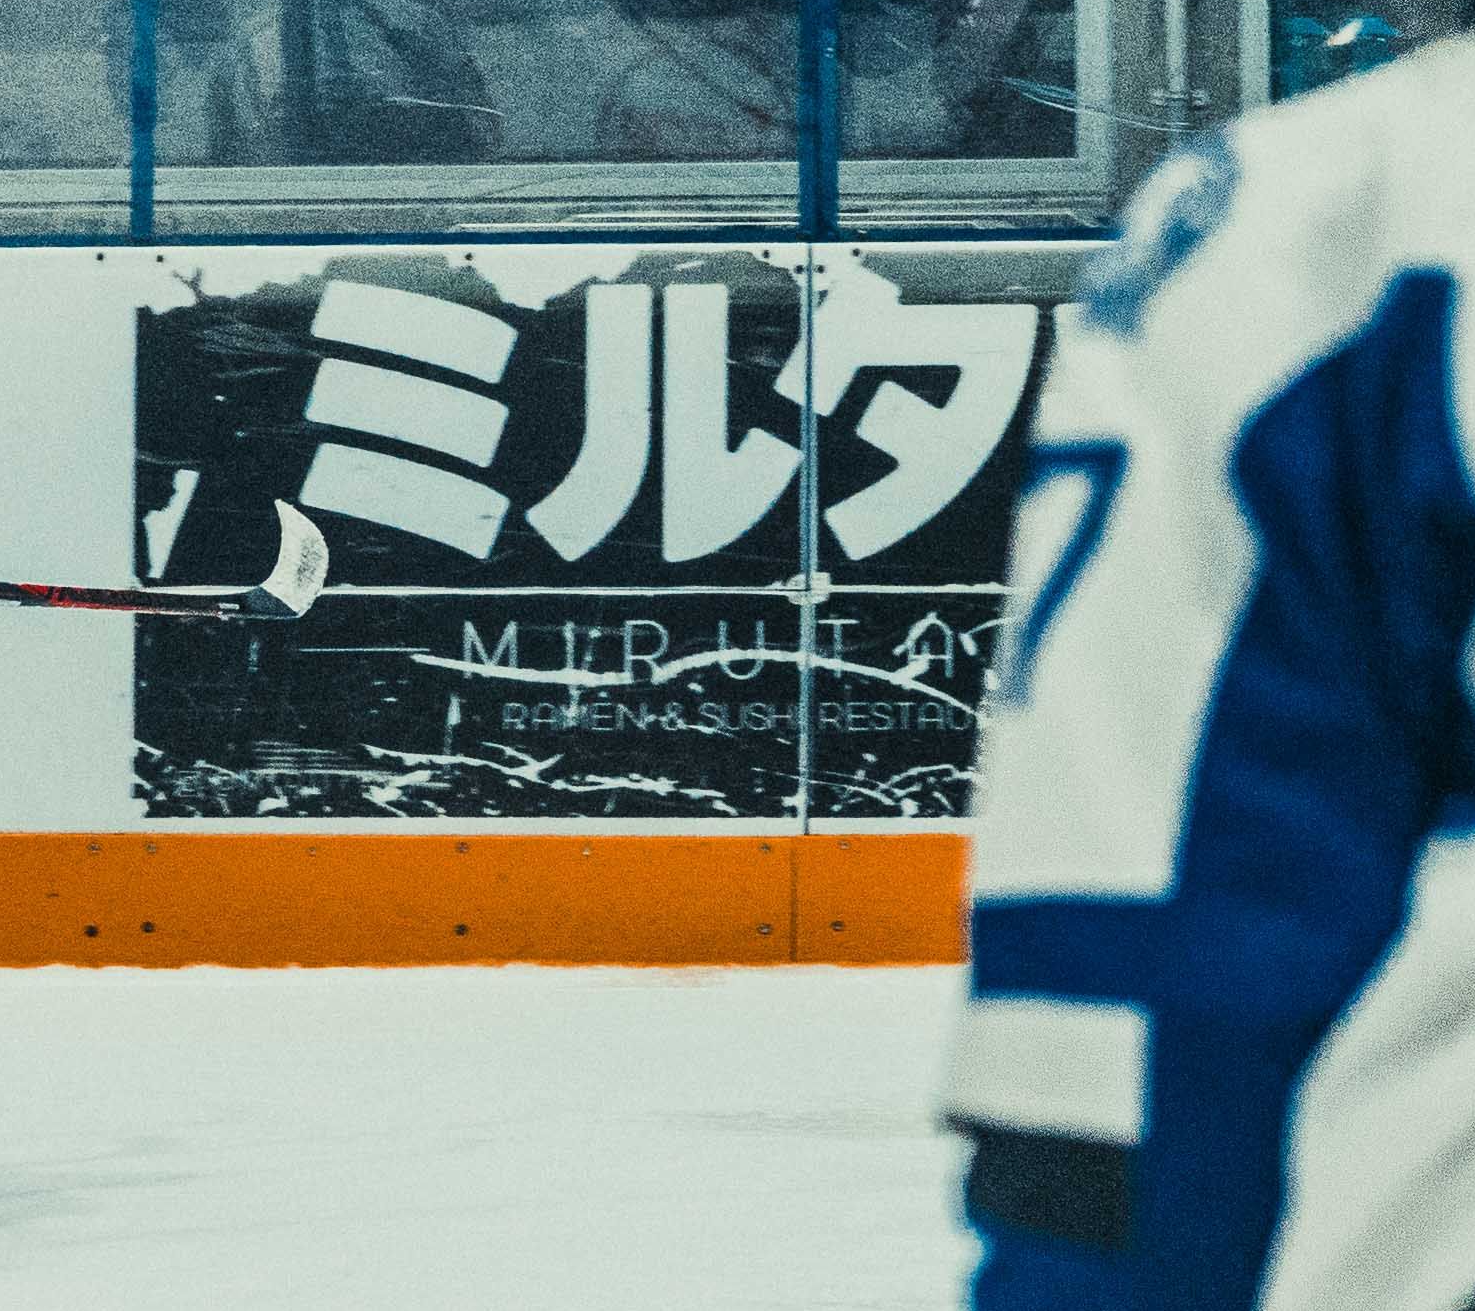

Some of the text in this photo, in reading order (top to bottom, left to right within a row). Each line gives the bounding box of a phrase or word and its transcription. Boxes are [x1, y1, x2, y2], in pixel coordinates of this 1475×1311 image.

[300, 264, 1082, 561] ミルタ
[698, 702, 810, 731] SUSH
